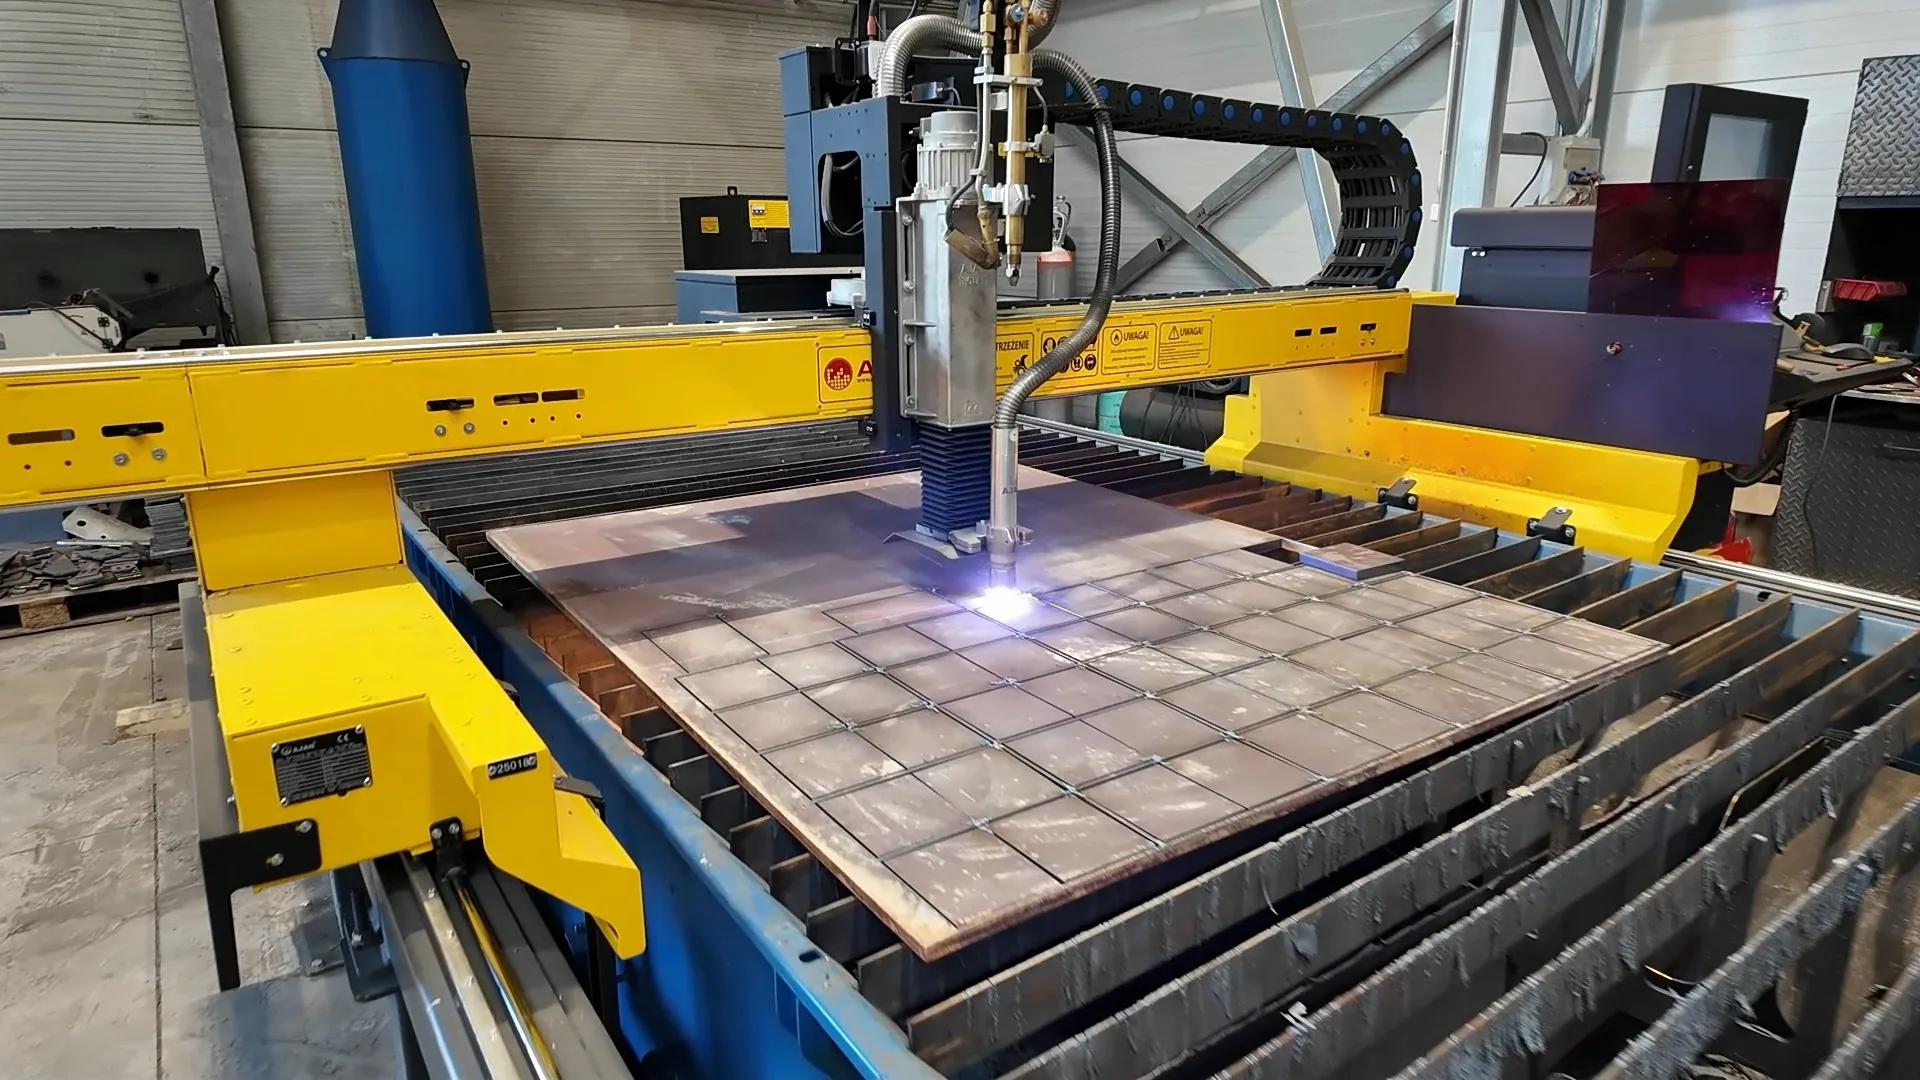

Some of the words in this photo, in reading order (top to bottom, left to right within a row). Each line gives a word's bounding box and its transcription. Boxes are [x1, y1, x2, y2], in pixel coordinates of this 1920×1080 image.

[1123, 331, 1149, 341] UWAGA!
[1179, 327, 1204, 337] UWAGA!
[337, 733, 350, 743] CE
